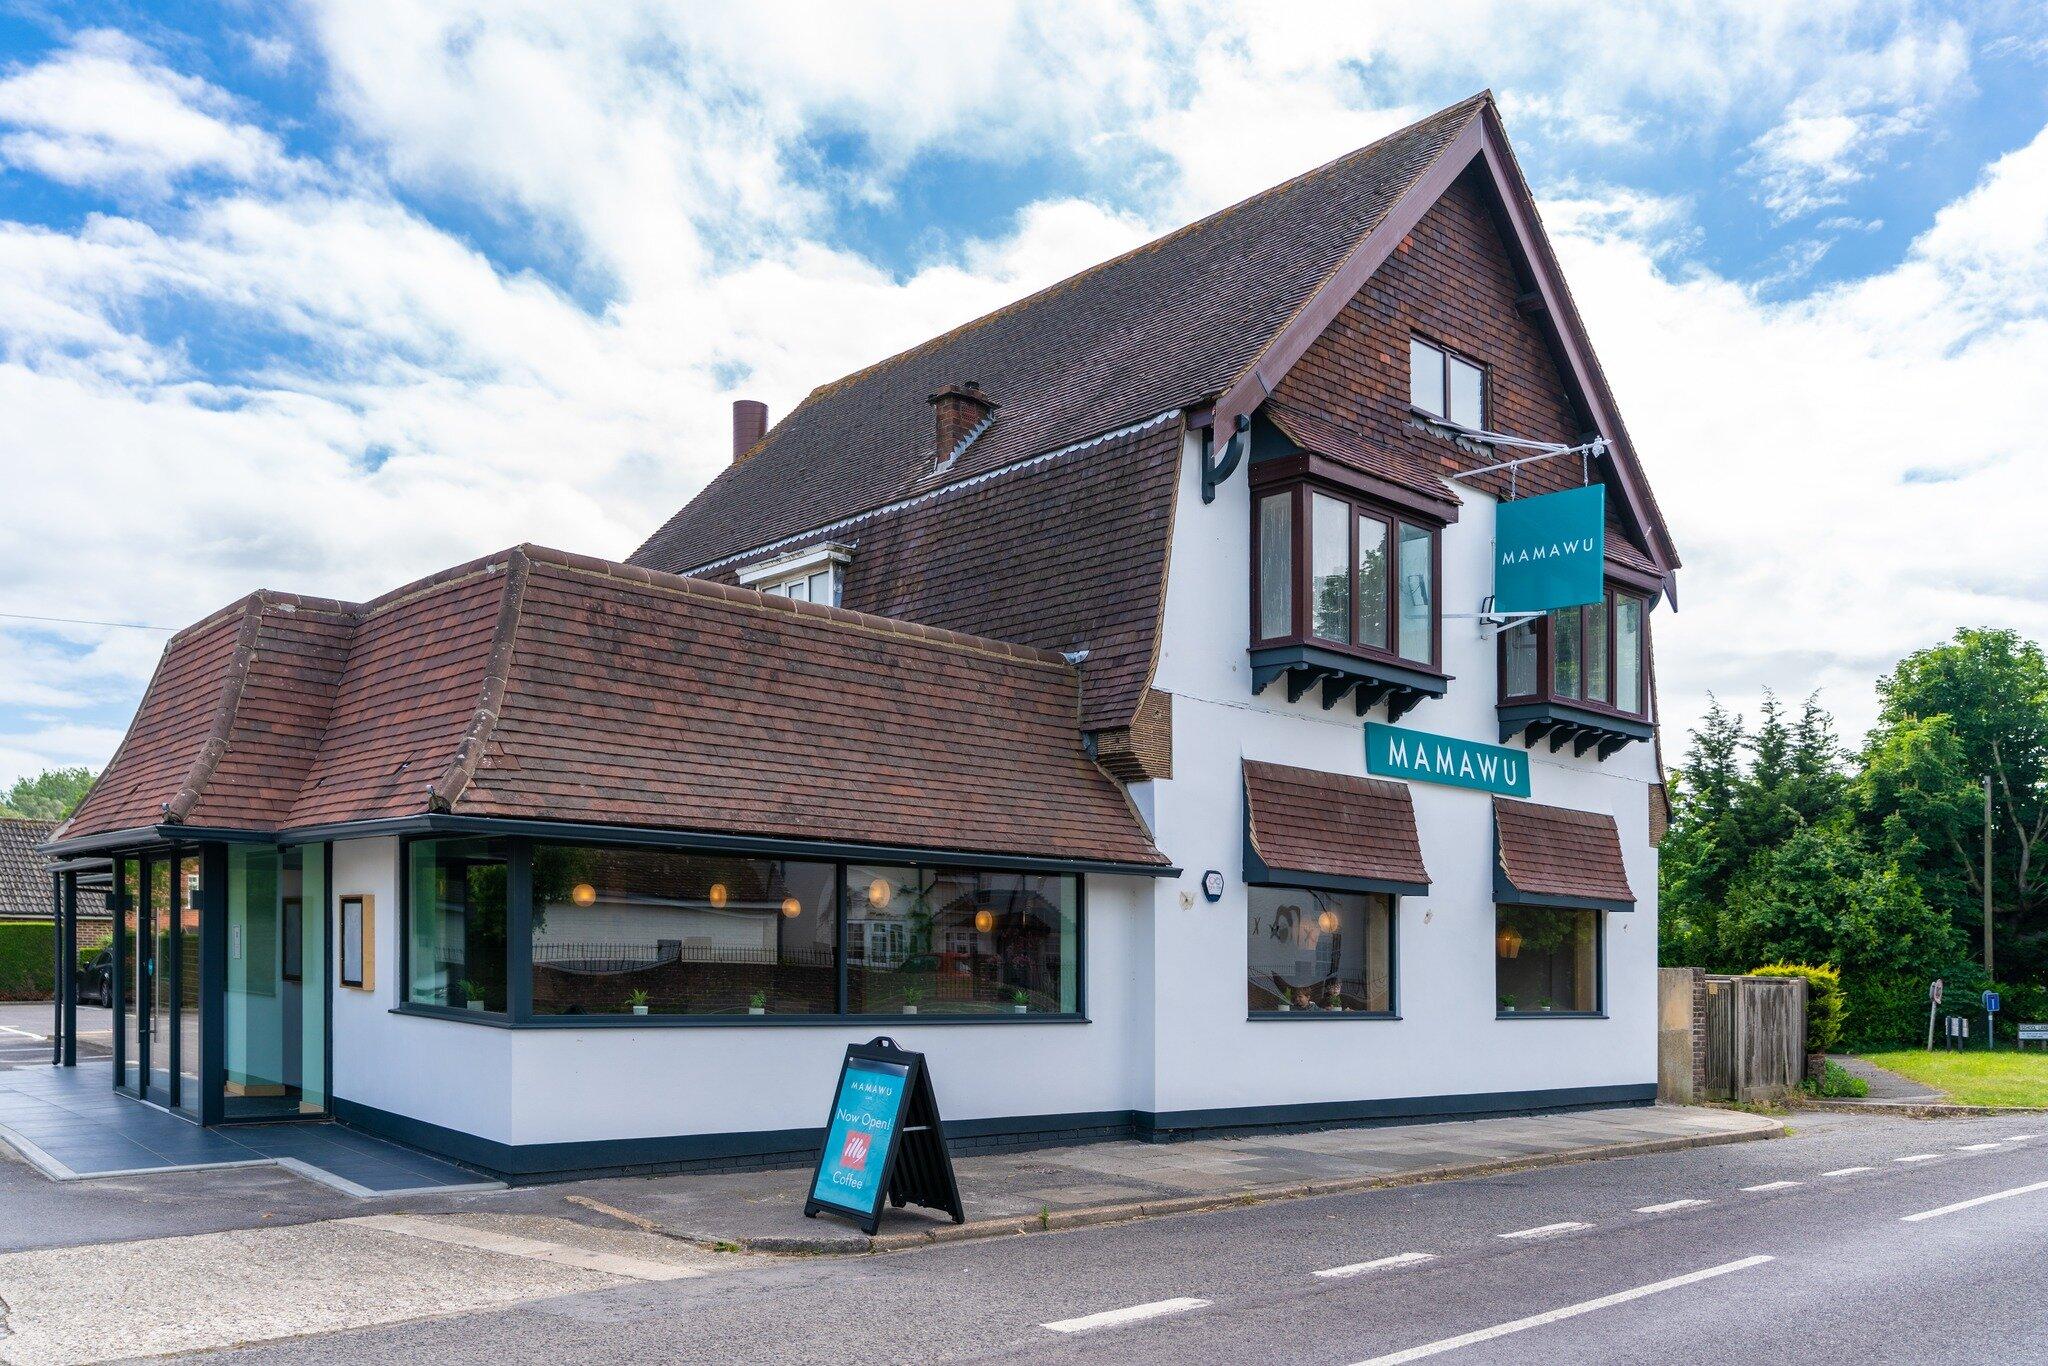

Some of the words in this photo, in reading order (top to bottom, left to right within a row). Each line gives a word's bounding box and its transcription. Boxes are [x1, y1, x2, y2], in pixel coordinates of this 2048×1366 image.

[1502, 538, 1594, 565] MAMAWU
[1389, 735, 1517, 786] MAMAWU
[851, 1082, 893, 1096] MAMAWU
[837, 1108, 860, 1122] Now
[862, 1113, 891, 1130] Open!
[844, 1137, 867, 1164] illy
[832, 1171, 863, 1189] Coffee
